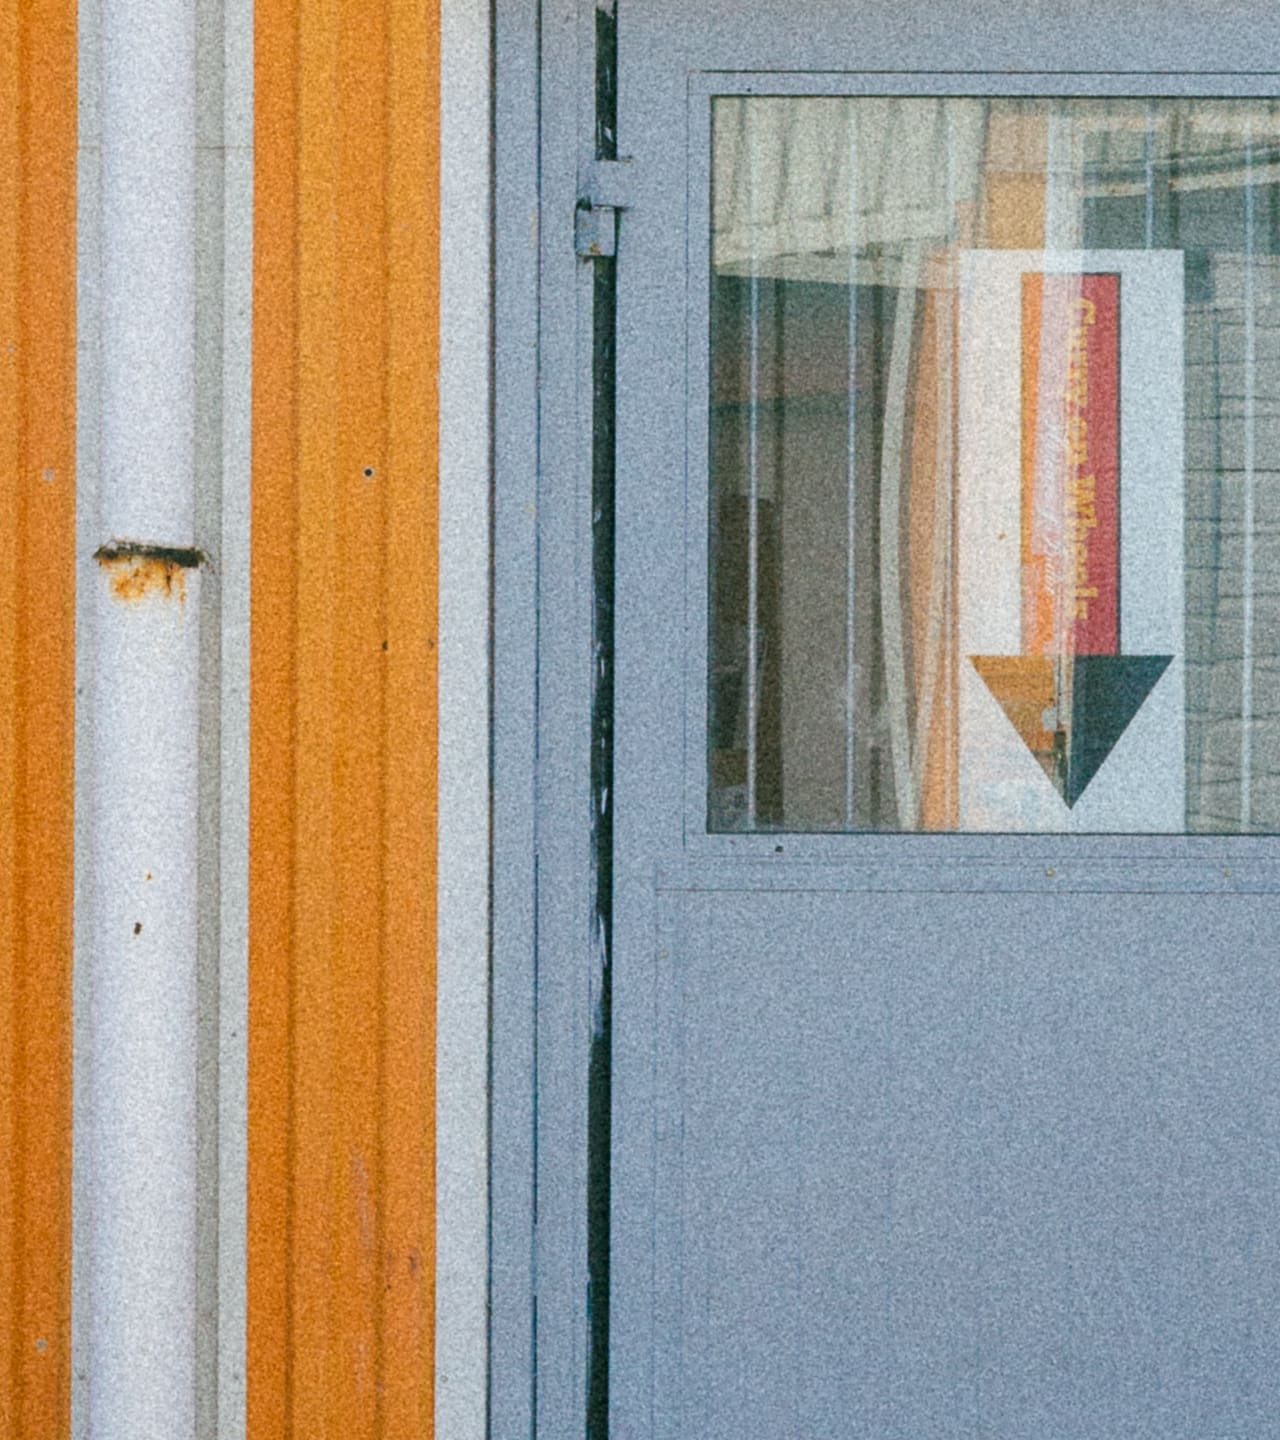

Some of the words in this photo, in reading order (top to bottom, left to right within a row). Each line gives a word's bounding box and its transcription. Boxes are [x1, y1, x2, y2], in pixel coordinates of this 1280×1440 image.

[1063, 296, 1097, 409] Curry
[1067, 417, 1088, 465] on
[1065, 474, 1099, 621] Wheels
